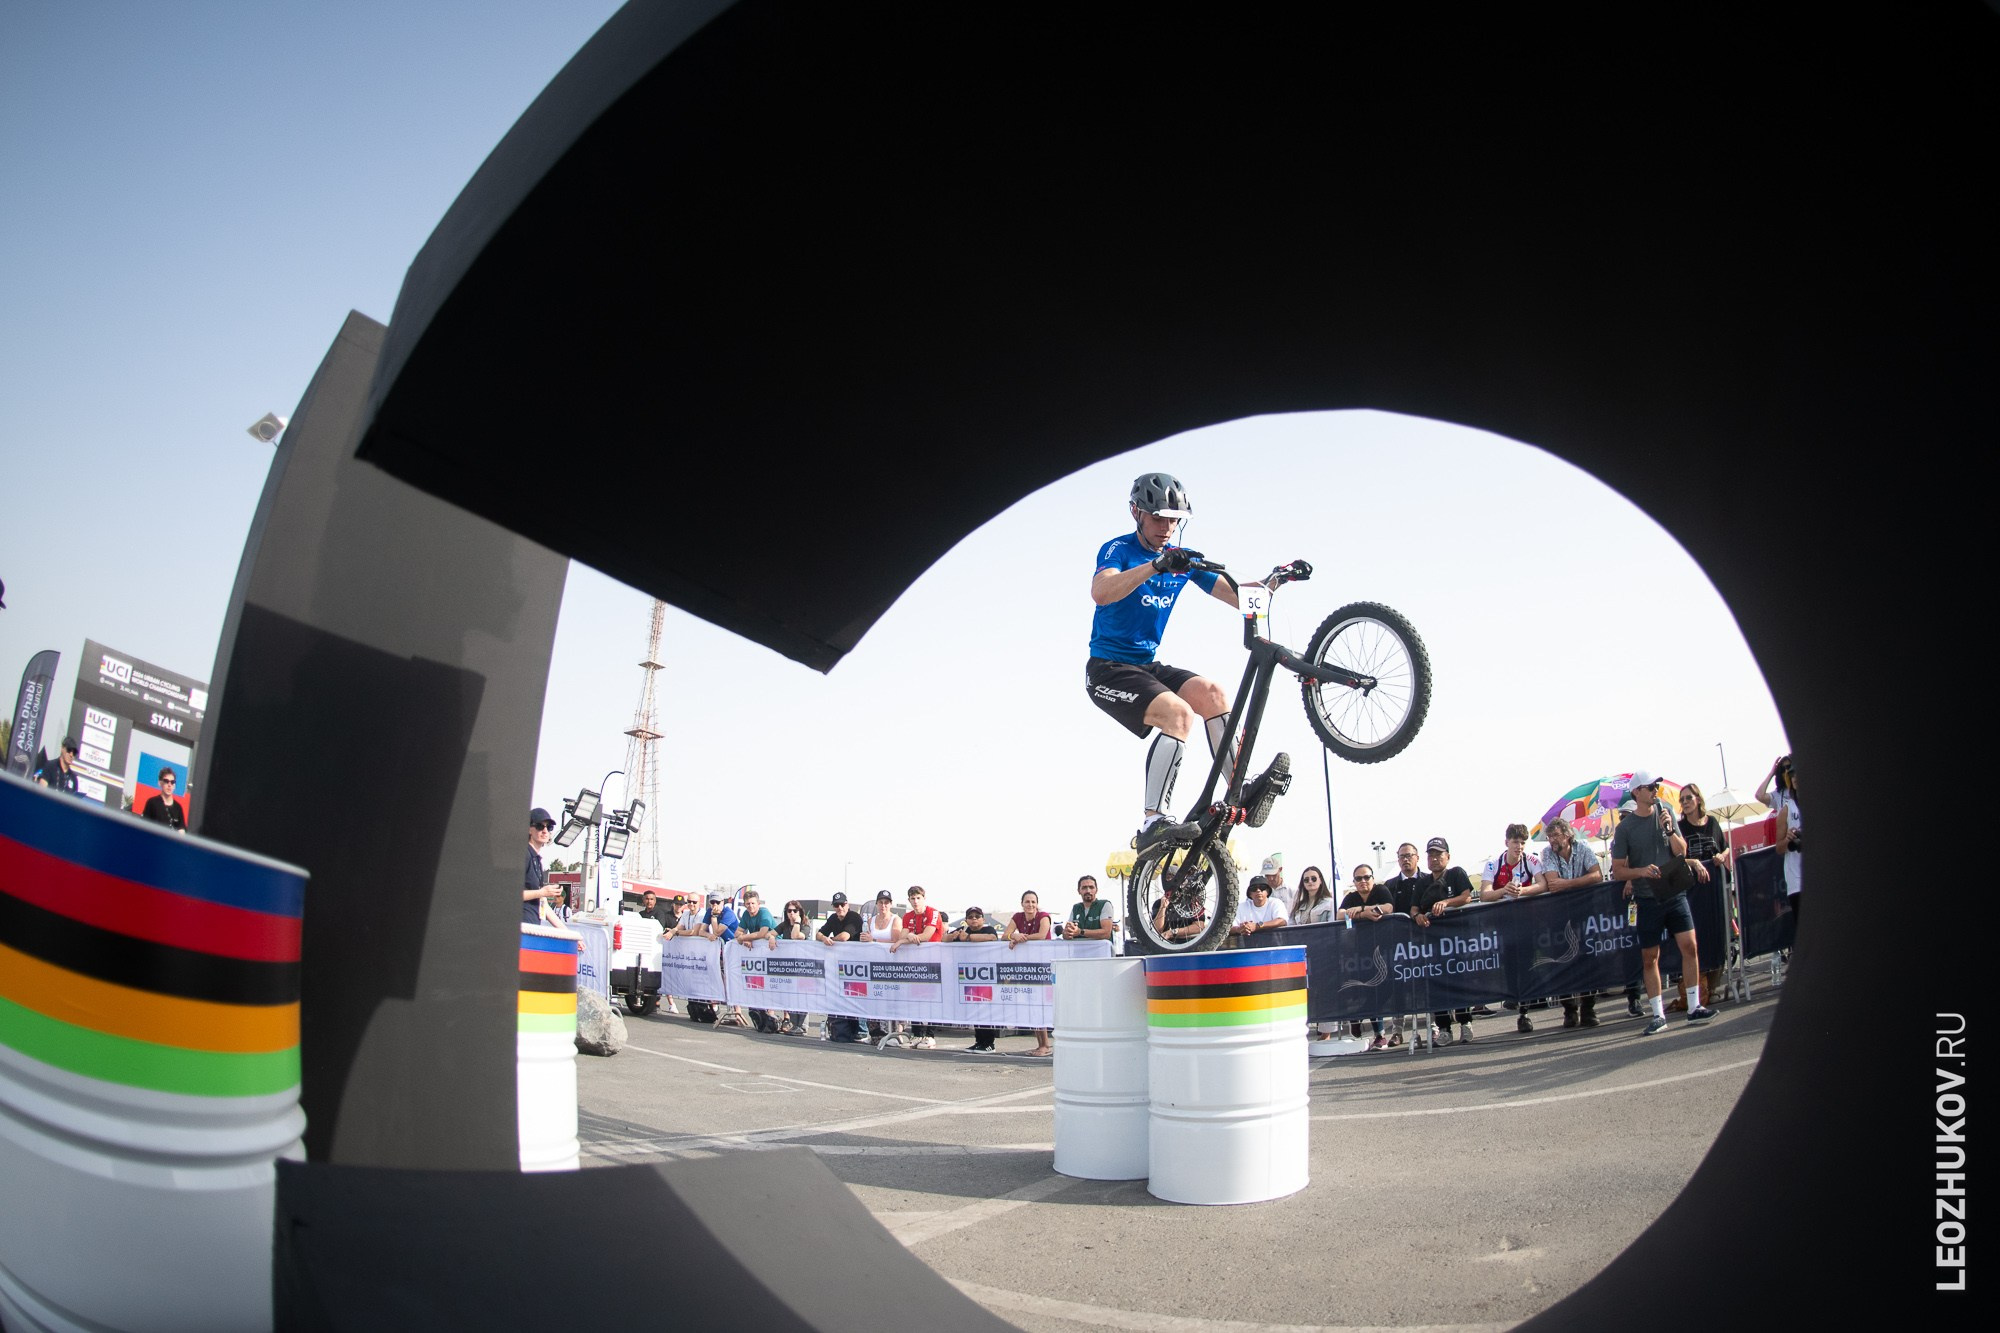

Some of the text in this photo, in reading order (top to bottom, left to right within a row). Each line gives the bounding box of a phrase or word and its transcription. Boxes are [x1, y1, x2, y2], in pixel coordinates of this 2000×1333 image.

[1141, 592, 1175, 609] enel
[1248, 597, 1262, 610] 5C
[106, 660, 130, 679] UCI
[16, 680, 37, 750] Abu Dhabi
[24, 683, 44, 752] Sports Council
[92, 713, 112, 729] UCI
[150, 712, 184, 733] START
[1584, 913, 1624, 935] Abu
[1393, 930, 1499, 961] Abu Dhabi
[1585, 934, 1633, 957] Sports
[577, 963, 597, 978] JEEL
[745, 960, 765, 972] UCI
[785, 967, 823, 975] CHAMPIONSHIPS
[844, 964, 869, 978] UCI
[965, 966, 994, 980] UCI
[1393, 962, 1443, 983] Sports
[1446, 952, 1500, 974] Council
[892, 972, 939, 980] CHAMPIONSHIPS
